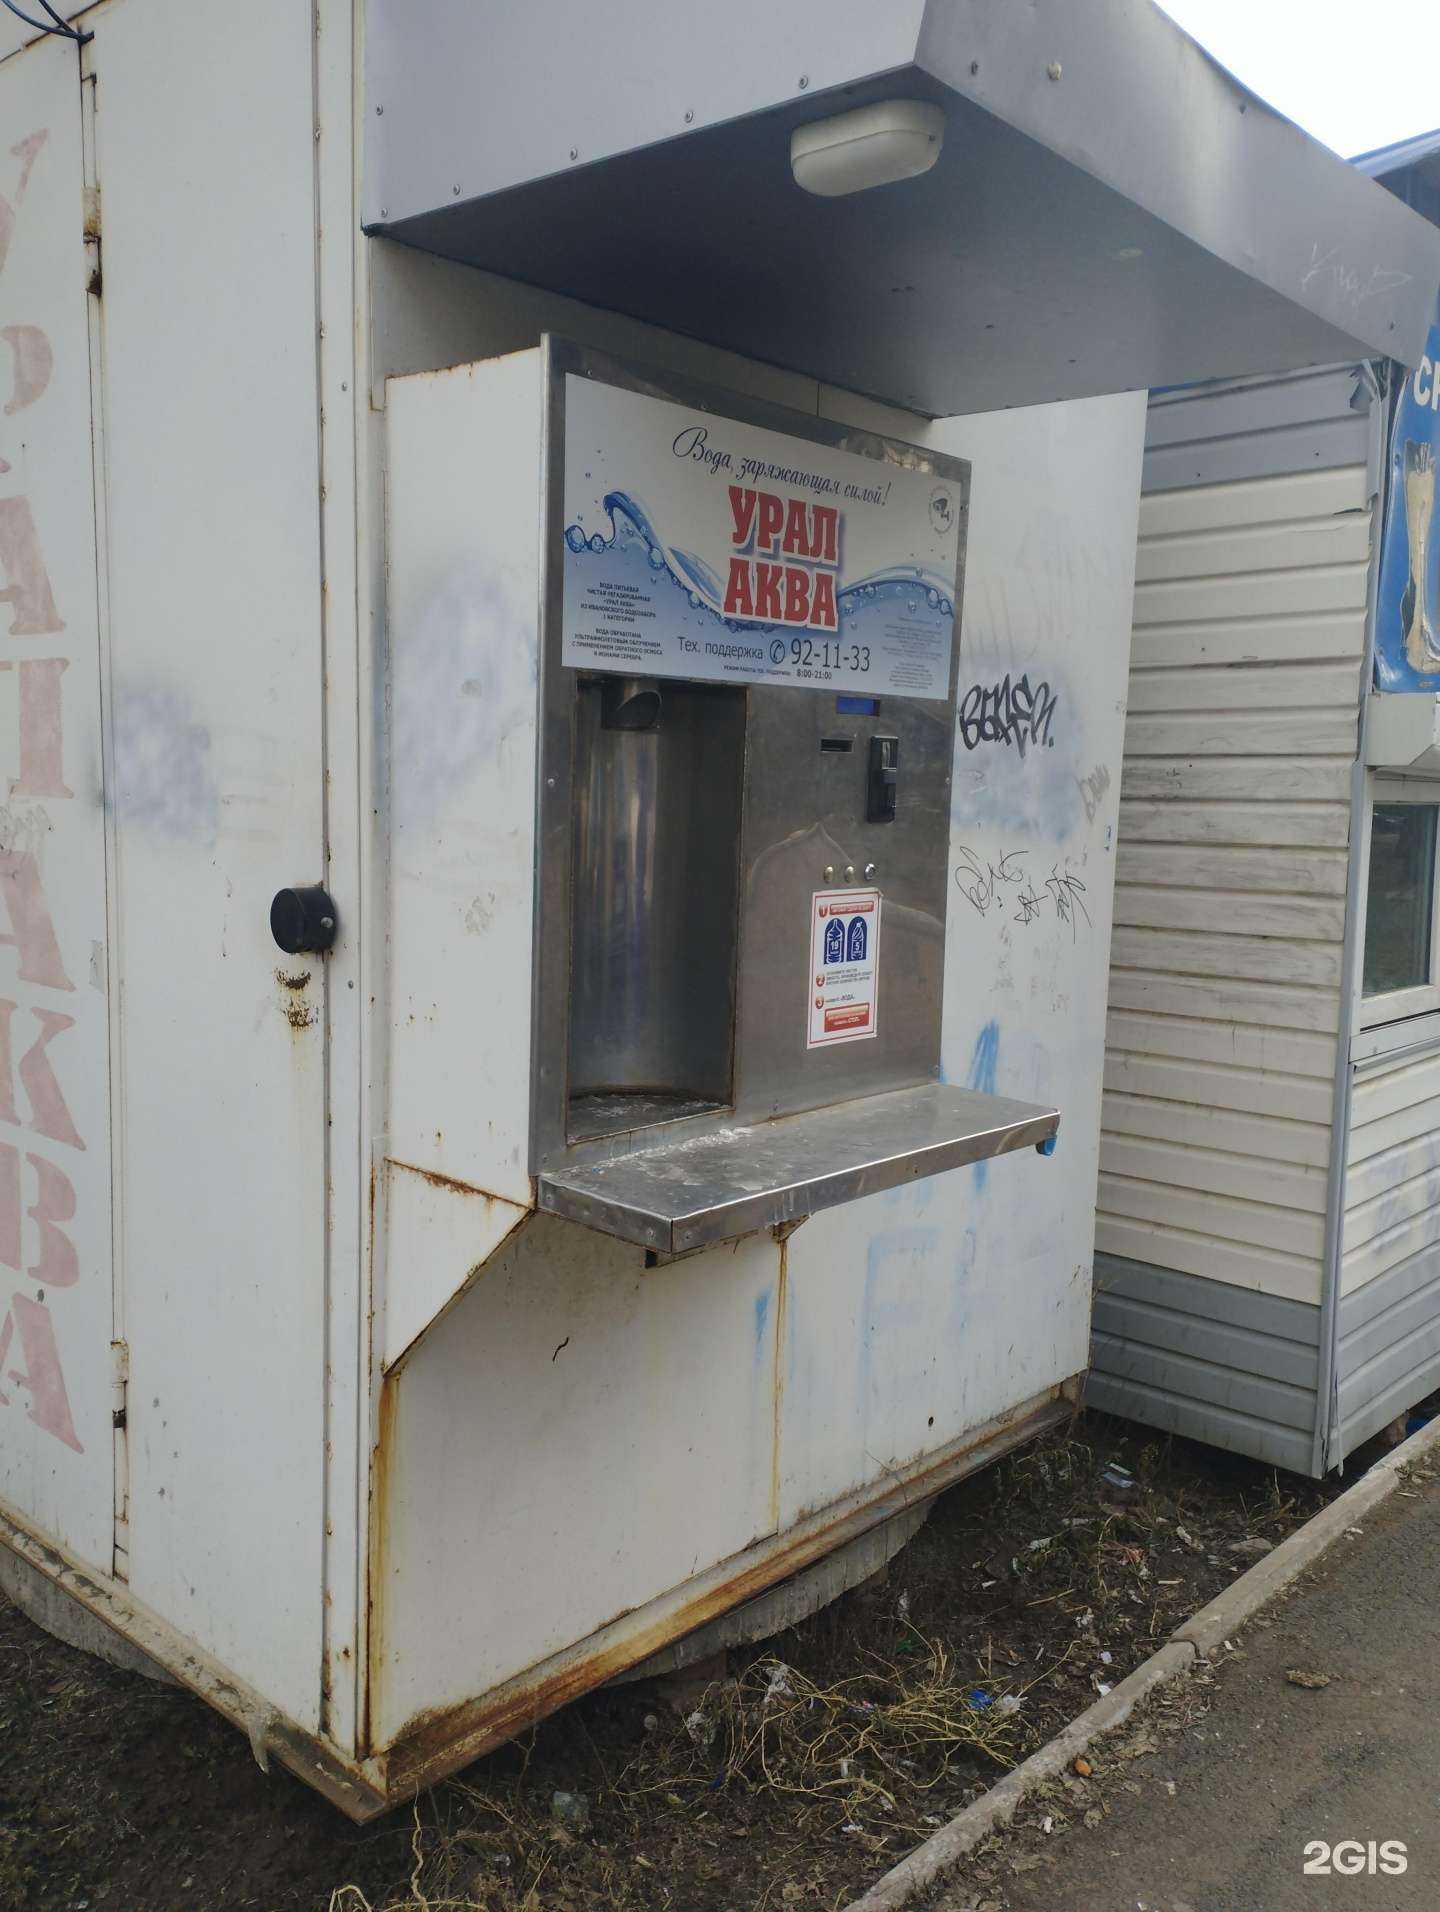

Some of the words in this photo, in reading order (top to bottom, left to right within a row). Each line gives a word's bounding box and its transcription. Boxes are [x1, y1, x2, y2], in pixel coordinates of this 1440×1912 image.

[672, 426, 734, 475] Вода,
[735, 456, 840, 495] заряжающая
[843, 481, 892, 507] силой!
[728, 485, 838, 562] УРАЛ
[723, 557, 837, 628] АКВА
[677, 636, 700, 653] Тех.
[705, 641, 764, 660] поддержка
[791, 638, 871, 672] 92-11-33
